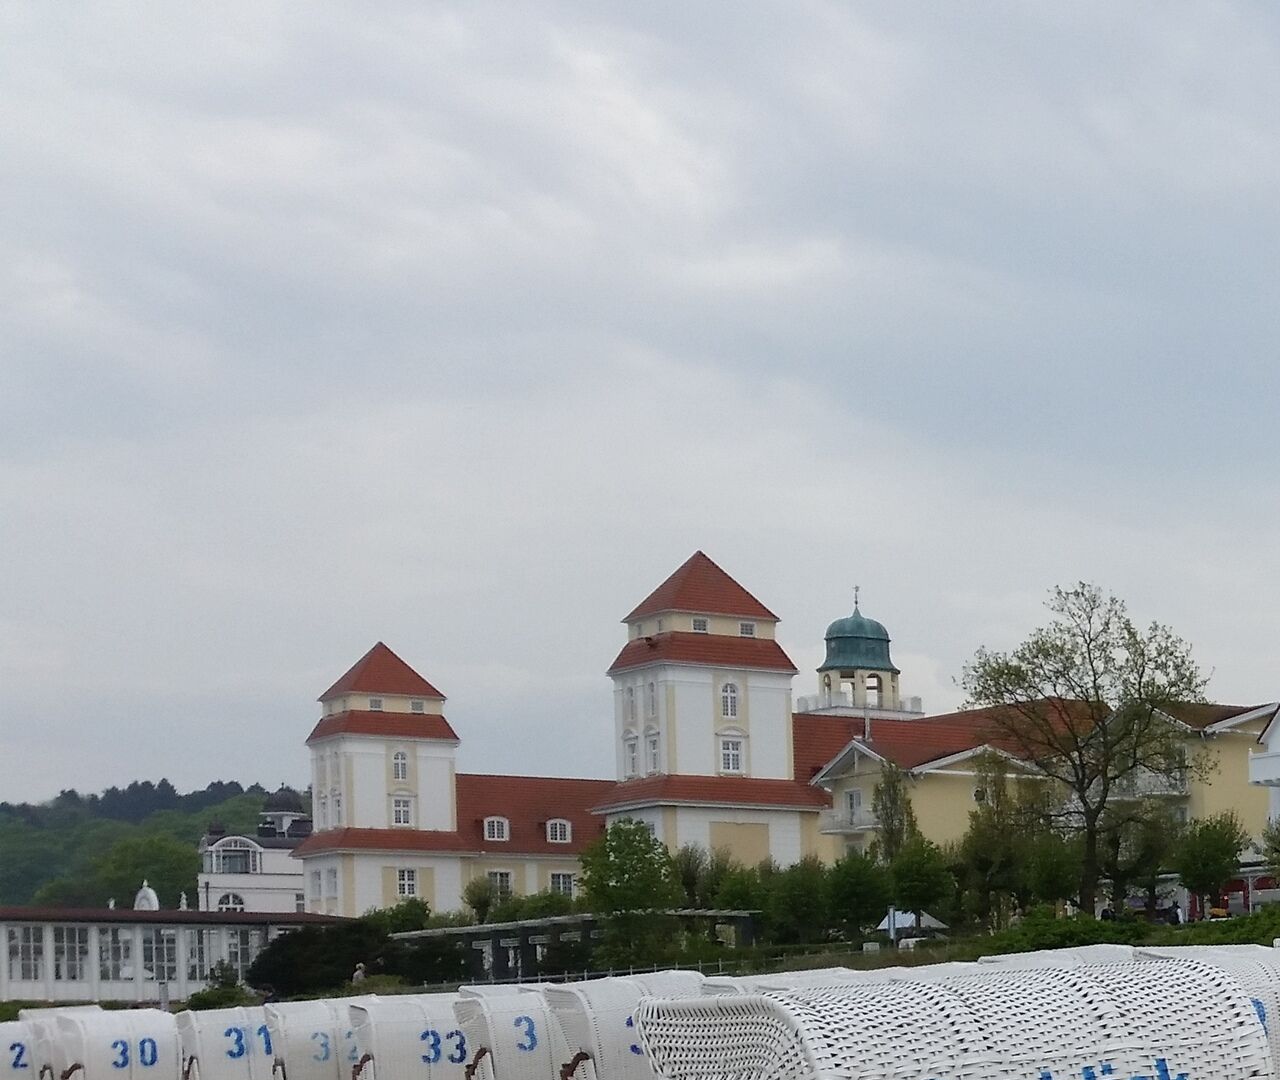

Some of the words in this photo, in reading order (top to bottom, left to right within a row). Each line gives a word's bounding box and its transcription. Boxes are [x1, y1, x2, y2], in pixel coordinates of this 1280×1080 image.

[111, 1037, 159, 1069] 30
[224, 1024, 273, 1060] 31
[420, 1029, 467, 1064] 33
